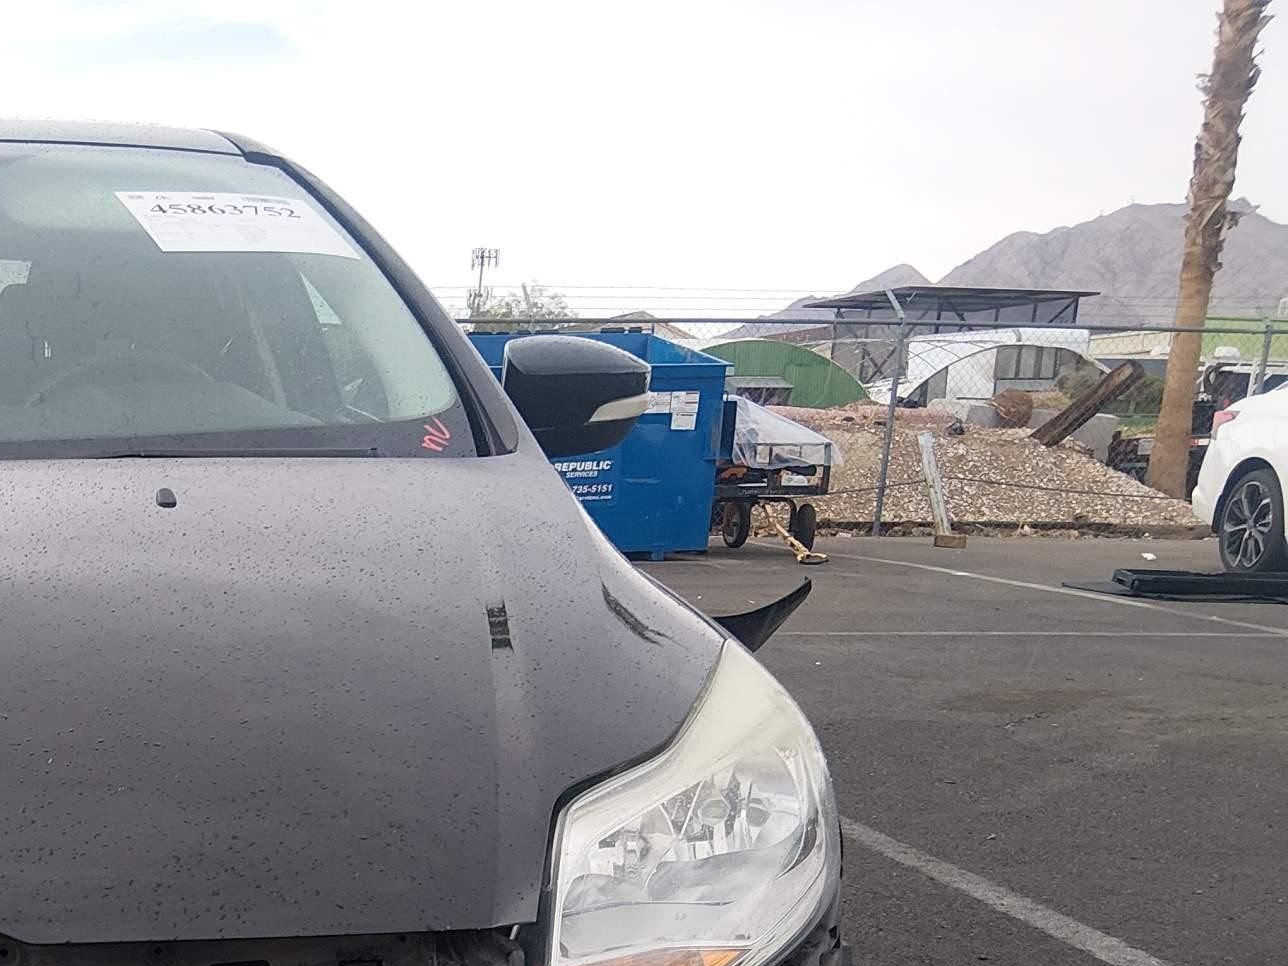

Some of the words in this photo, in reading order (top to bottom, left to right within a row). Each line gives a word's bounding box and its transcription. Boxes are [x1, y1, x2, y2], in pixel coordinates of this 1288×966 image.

[149, 203, 302, 219] 45863752
[554, 460, 612, 472] REPUBLIC
[565, 471, 599, 479] SERVICES
